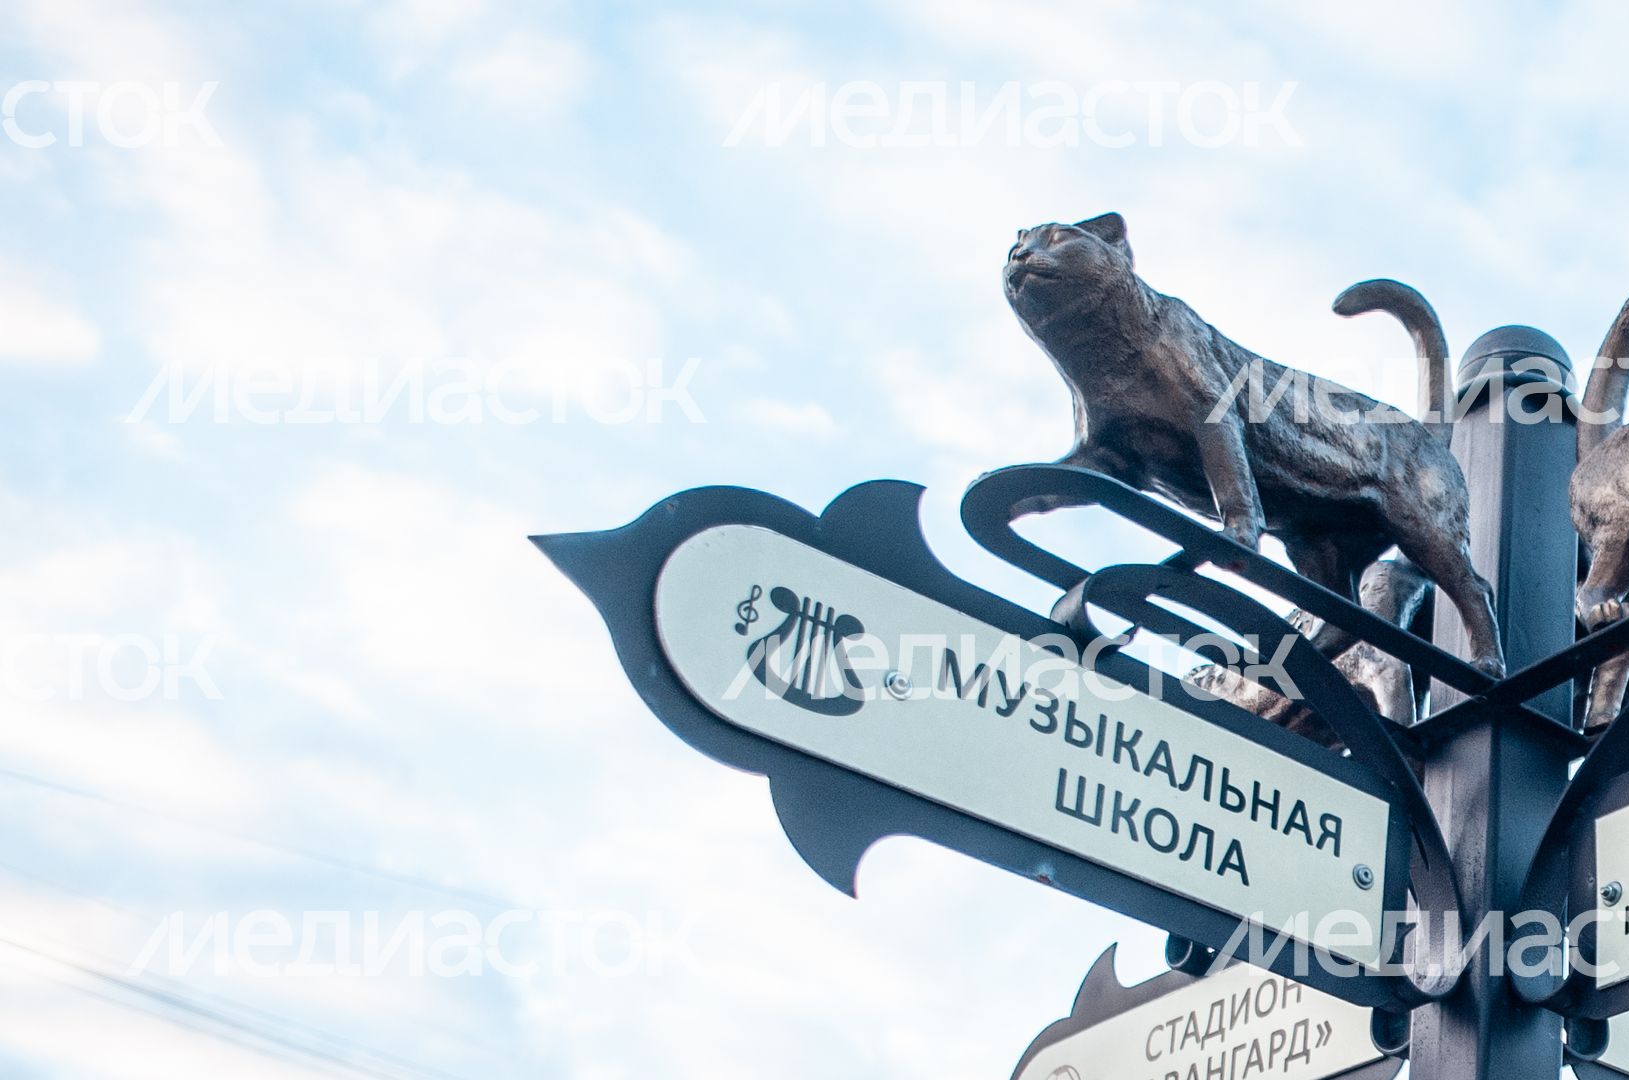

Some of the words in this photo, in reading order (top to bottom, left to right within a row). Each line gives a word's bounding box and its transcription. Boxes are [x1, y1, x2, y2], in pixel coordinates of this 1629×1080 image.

[937, 647, 1343, 858] МУЗЫКАЛЬНАЯ
[1054, 767, 1250, 886] ШКОЛА
[1145, 977, 1302, 1062] СТАДИОН
